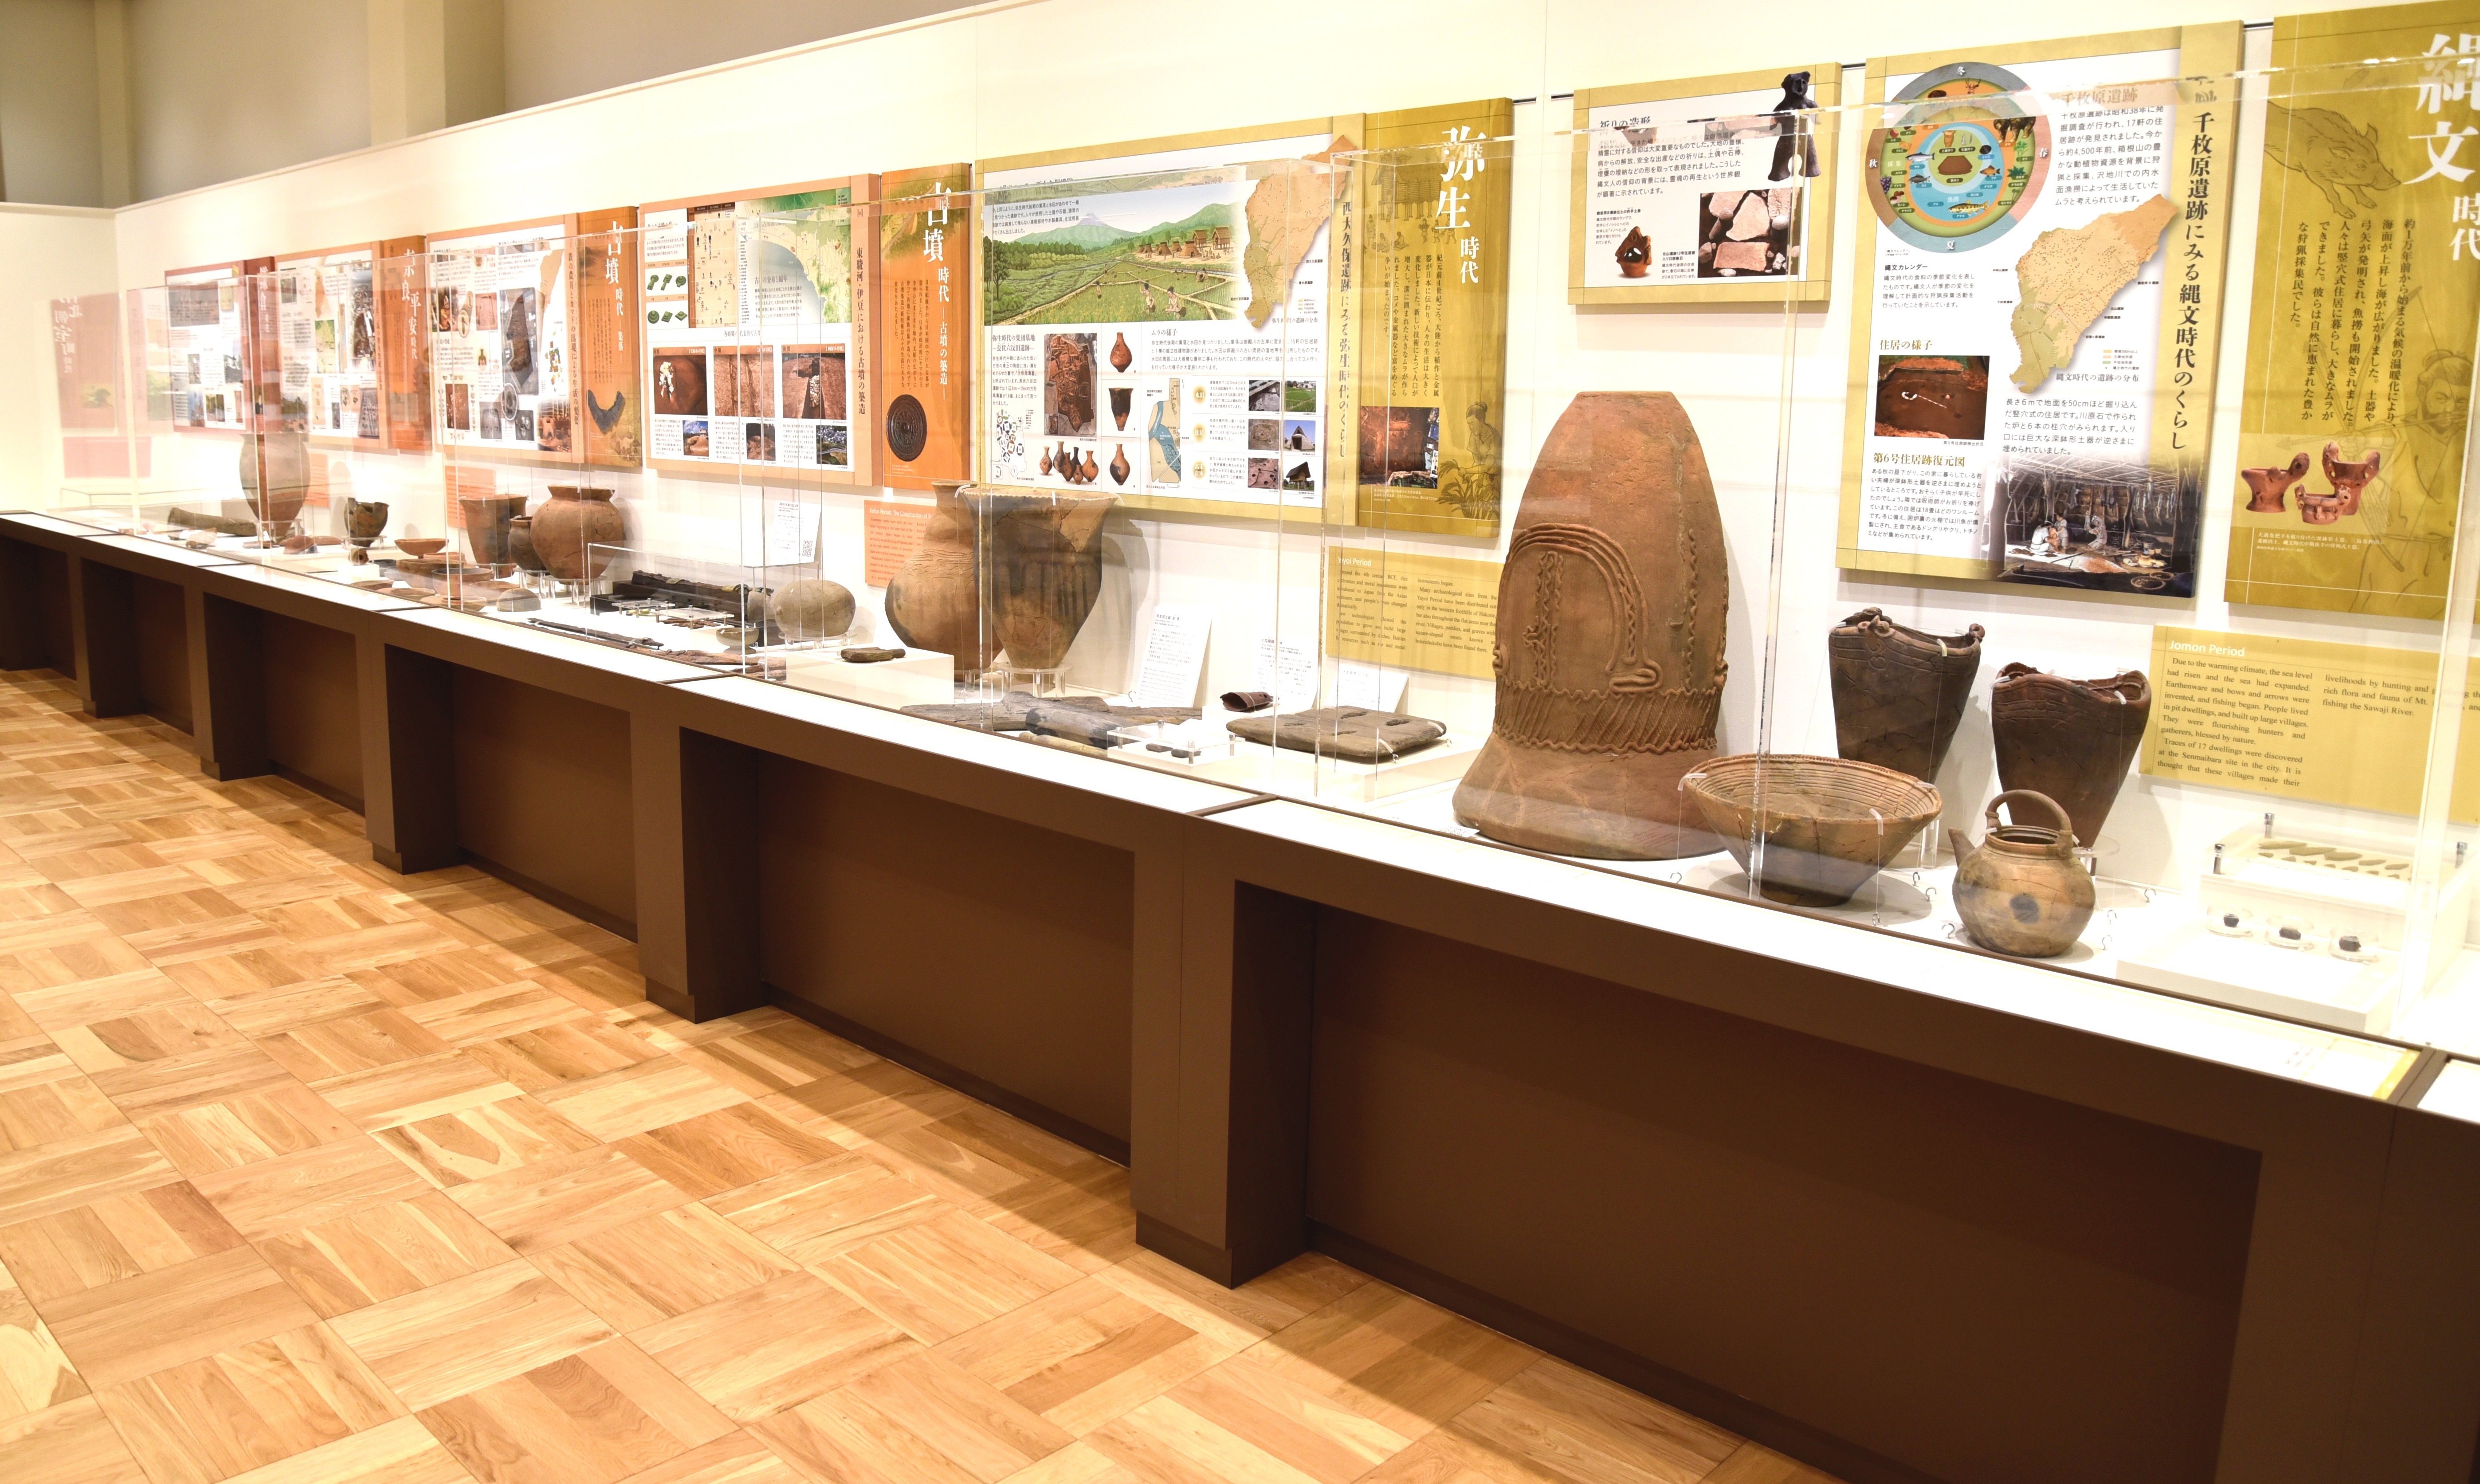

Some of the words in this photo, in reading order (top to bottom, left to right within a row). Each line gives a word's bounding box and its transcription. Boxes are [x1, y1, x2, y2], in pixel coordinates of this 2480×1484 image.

[1956, 66, 1966, 76] 冬
[2059, 130, 2162, 144] 居跡が発見されました。今か
[2039, 147, 2048, 157] 春
[1869, 159, 1877, 168] 秋
[2058, 156, 2161, 169] かな動植物資源を背景に狩
[2055, 195, 2140, 206] ムラと考えられています。
[1947, 241, 1954, 250] 夏
[2172, 112, 2214, 449] 千枚原遺跡にみる縄文時代のくらし
[2290, 222, 2309, 329] な狩猟採集民でした。
[1880, 339, 1933, 350] 住居の様子
[2056, 373, 2139, 382] 縄文時代の遺跡の分布
[2003, 445, 2071, 455] 埋められていました。
[1873, 452, 1965, 467] 第6号住居跡復元図
[1353, 557, 1372, 567] Period
[1433, 588, 1463, 597] archaeological
[2169, 640, 2206, 653] Jomon
[2209, 644, 2245, 657] Period
[2208, 663, 2238, 672] warming
[2240, 665, 2268, 675] climate,
[2167, 668, 2179, 676] had
[2274, 683, 2311, 691] expanded.
[2325, 674, 2366, 685] livelihoods
[2369, 679, 2378, 688] by
[2382, 681, 2411, 692] hunting
[2166, 680, 2208, 691] Earthenware
[2227, 687, 2245, 696] bows
[2342, 688, 2358, 697] flora
[2379, 693, 2400, 702] fauna
[2165, 691, 2195, 702] invented,
[2212, 697, 2236, 708] fishing
[2238, 700, 2261, 710] began.
[2264, 703, 2288, 714] People
[2290, 707, 2308, 715] lived
[2323, 699, 2347, 710] fishing
[2363, 704, 2389, 714] Sawaji
[2391, 707, 2413, 715] River.
[2182, 705, 2217, 716] dwellings,
[2232, 711, 2248, 720] built
[2260, 715, 2278, 725] large
[2279, 718, 2308, 728] villages.
[2162, 714, 2179, 724] They
[2212, 721, 2249, 734] flourishing
[2258, 726, 2284, 736] hunters
[2160, 727, 2193, 736] gatherers,
[2195, 730, 2220, 740] blessed
[2222, 734, 2231, 742] by
[2164, 738, 2186, 747] Traces
[2209, 744, 2242, 755] dwellings
[2264, 752, 2303, 763] discovered
[2182, 751, 2222, 763] Senmaibara
[2266, 764, 2281, 773] city.
[2157, 760, 2182, 770] thought
[2205, 767, 2223, 775] these
[2228, 770, 2254, 781] villages
[2283, 778, 2300, 786] their
